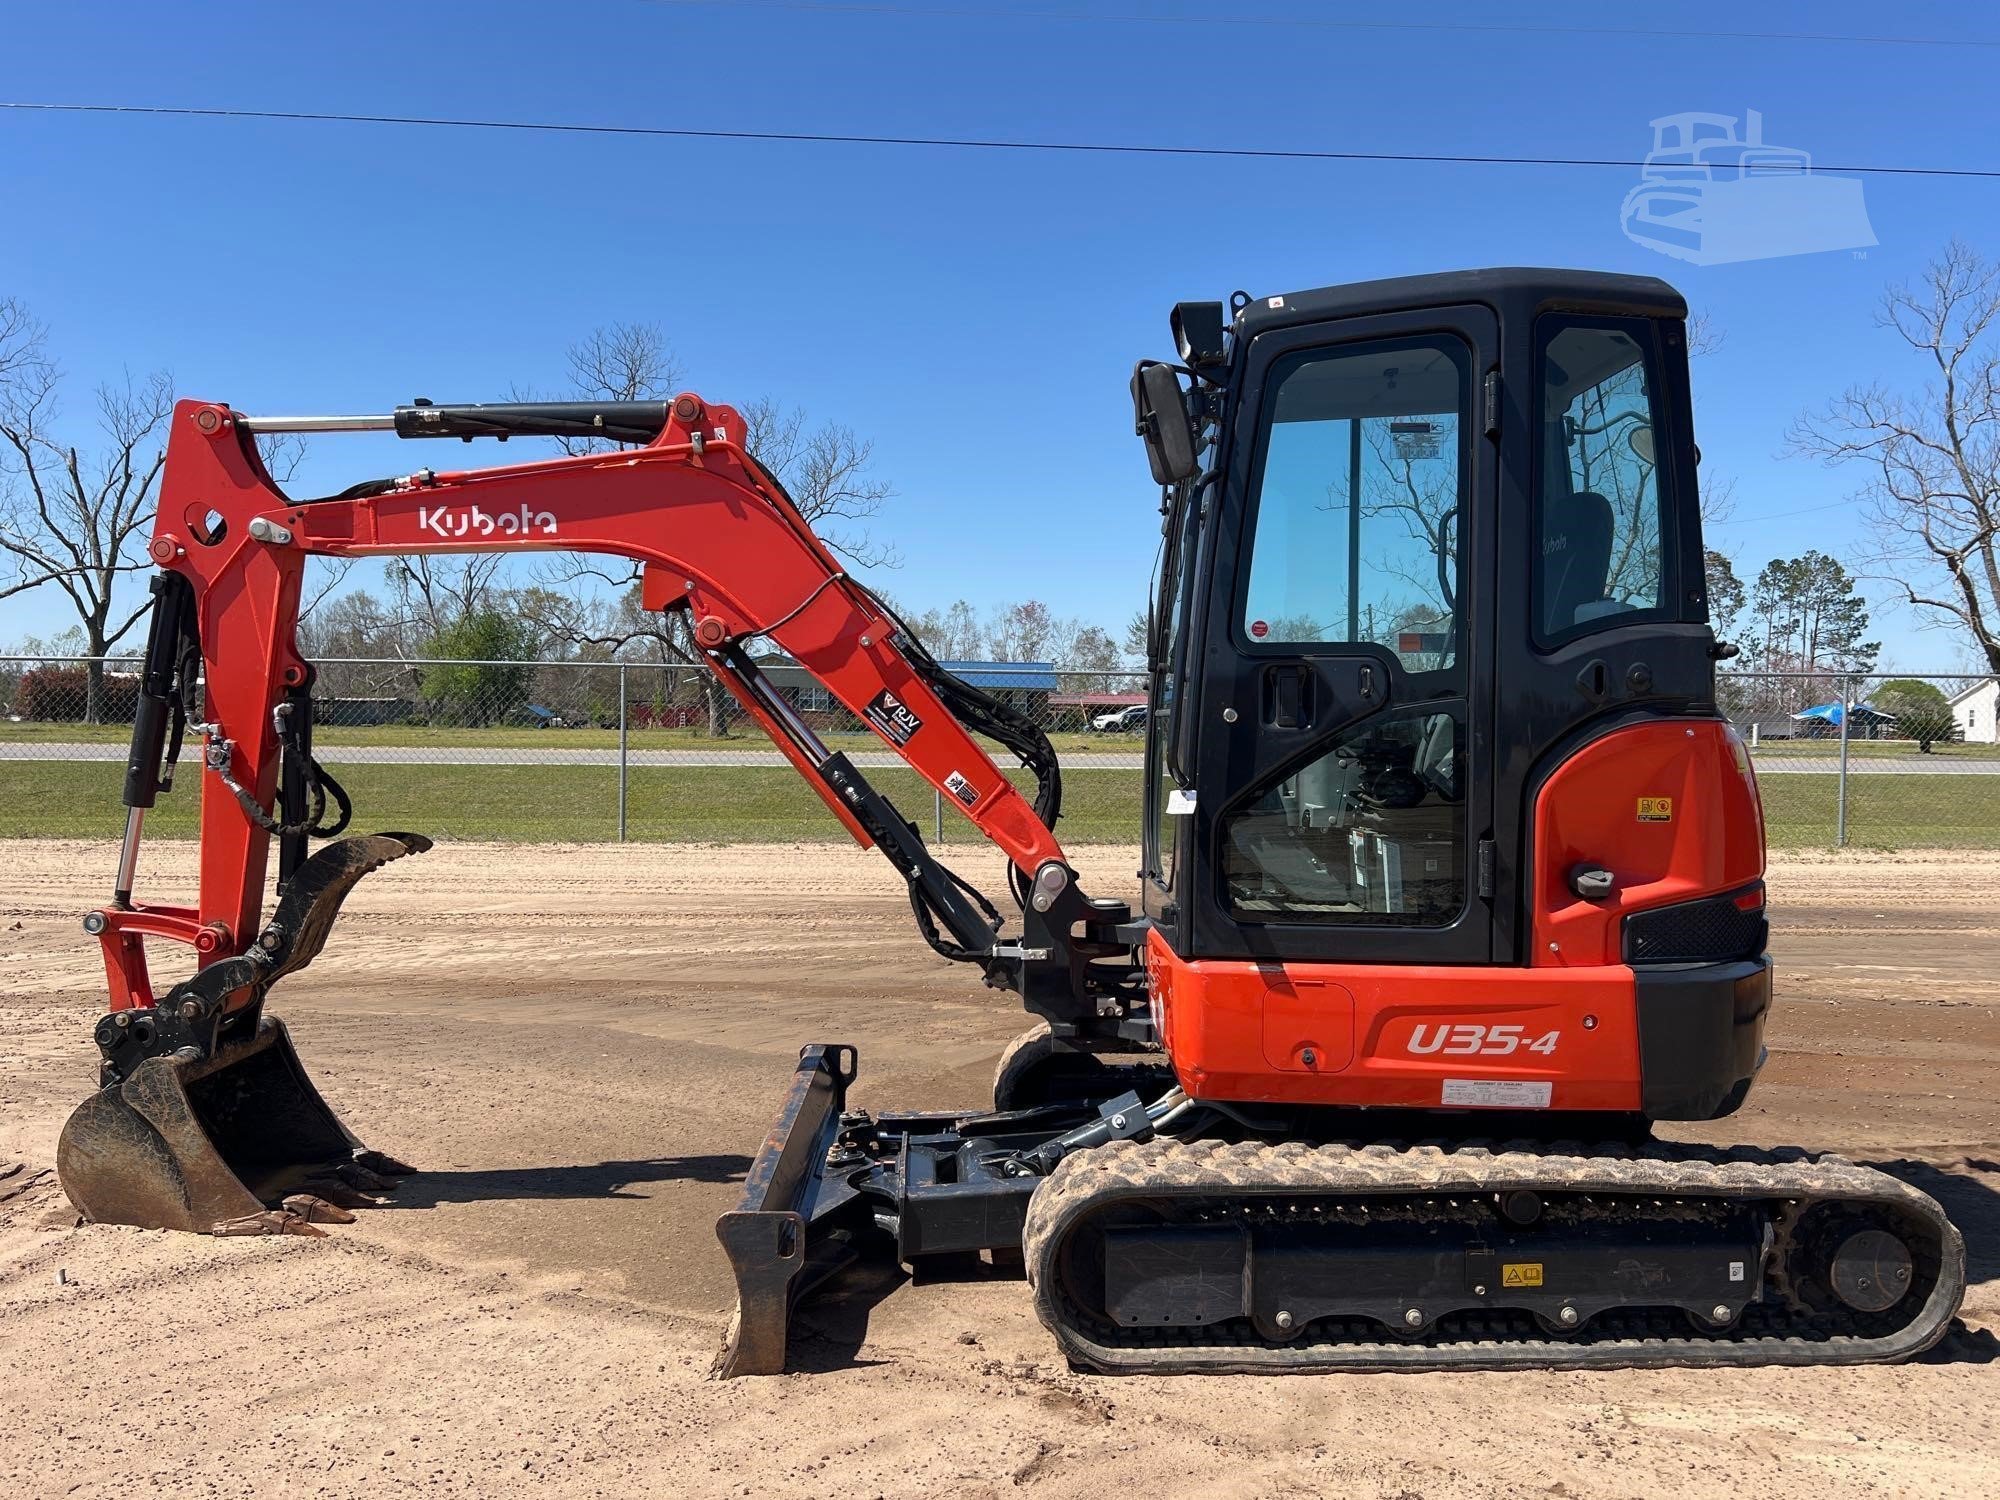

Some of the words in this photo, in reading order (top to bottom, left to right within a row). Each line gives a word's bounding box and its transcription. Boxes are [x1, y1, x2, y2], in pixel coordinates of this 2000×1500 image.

[419, 503, 558, 537] Kubota
[892, 713, 912, 733] Equipment
[895, 706, 920, 728] RJV
[1406, 1024, 1560, 1055] U35-4
